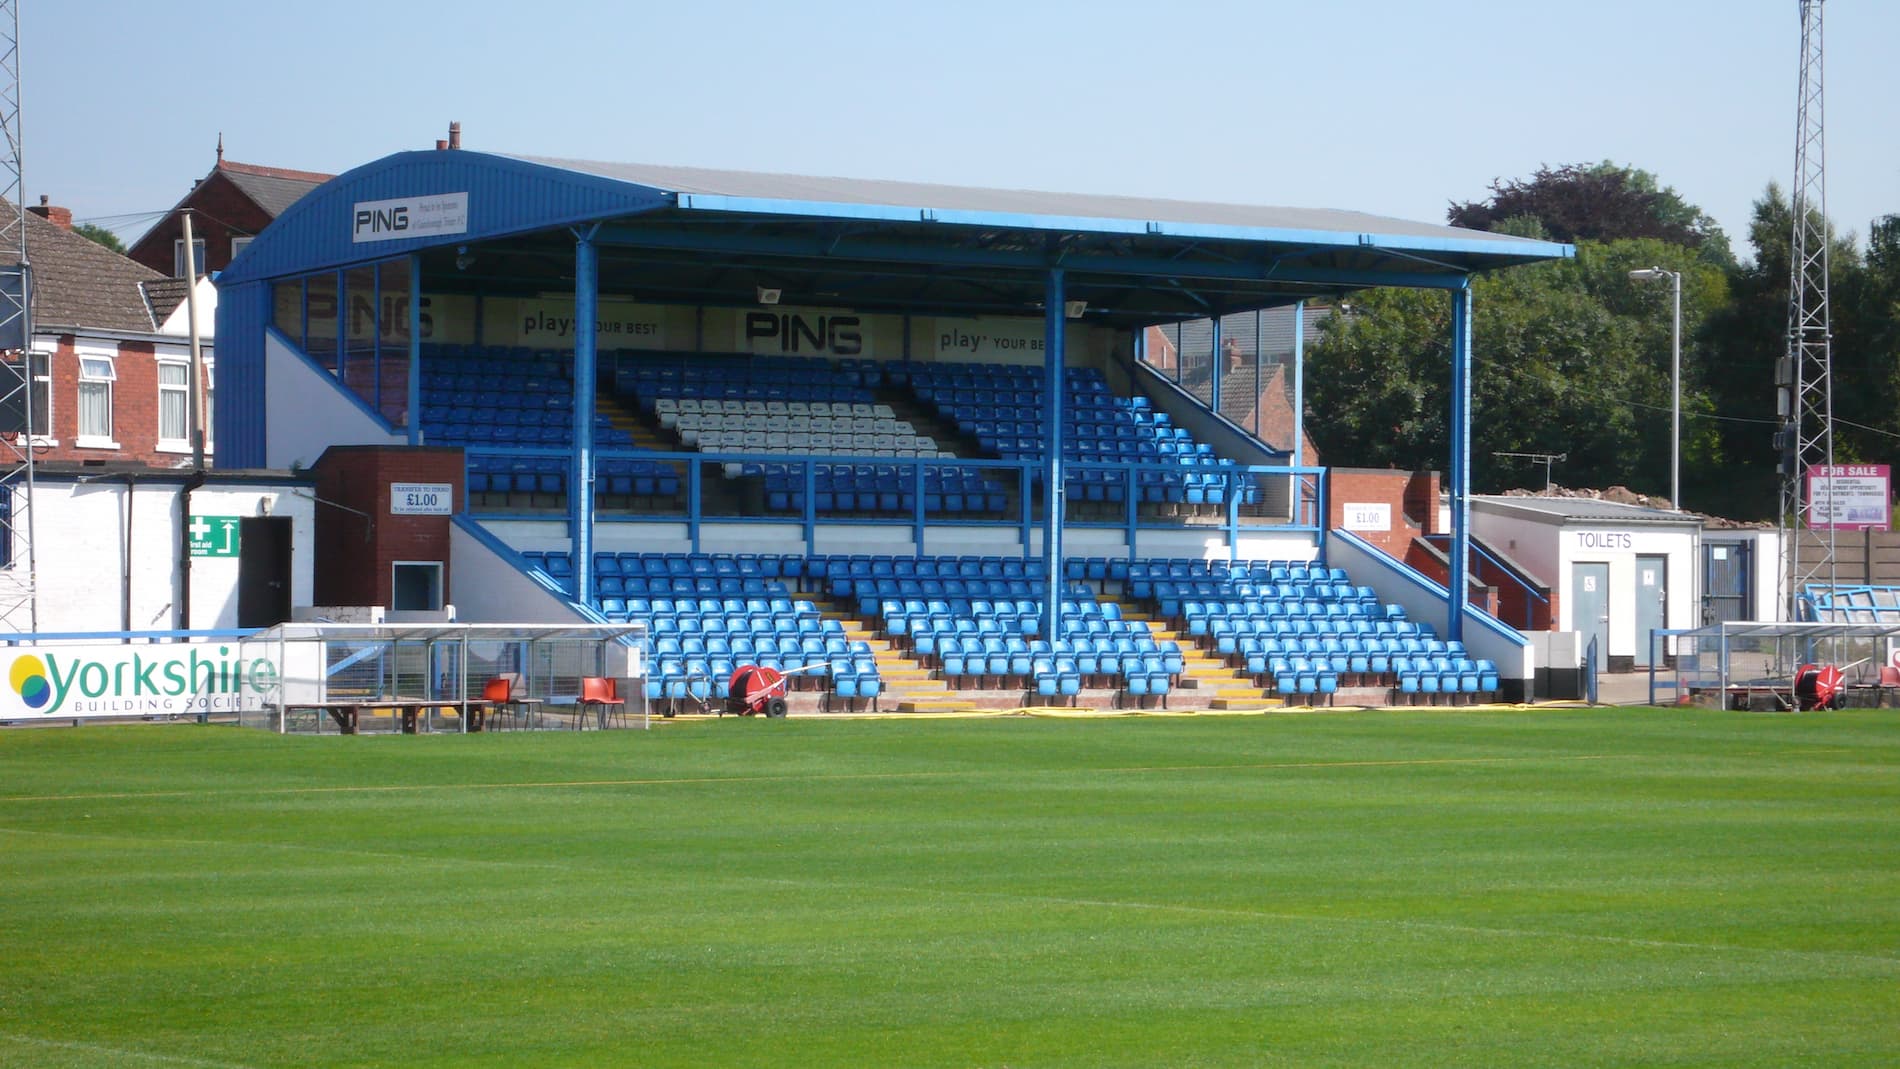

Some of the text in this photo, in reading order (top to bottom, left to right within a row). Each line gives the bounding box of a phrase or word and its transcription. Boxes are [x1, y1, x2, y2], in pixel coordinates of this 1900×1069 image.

[356, 206, 409, 234] PING
[305, 293, 433, 338] PNG
[596, 320, 621, 333] OUR
[626, 322, 657, 335] BEST
[746, 311, 863, 355] PING
[993, 337, 1026, 351] YOUR
[1031, 339, 1045, 351] BE
[1820, 466, 1878, 476] FOR SALE
[406, 493, 438, 506] £1.00
[1356, 511, 1380, 523] £1.00
[1577, 532, 1632, 549] TOILETS
[44, 645, 278, 714] yorkshire
[75, 696, 272, 712] BUILDING SOCIETY
